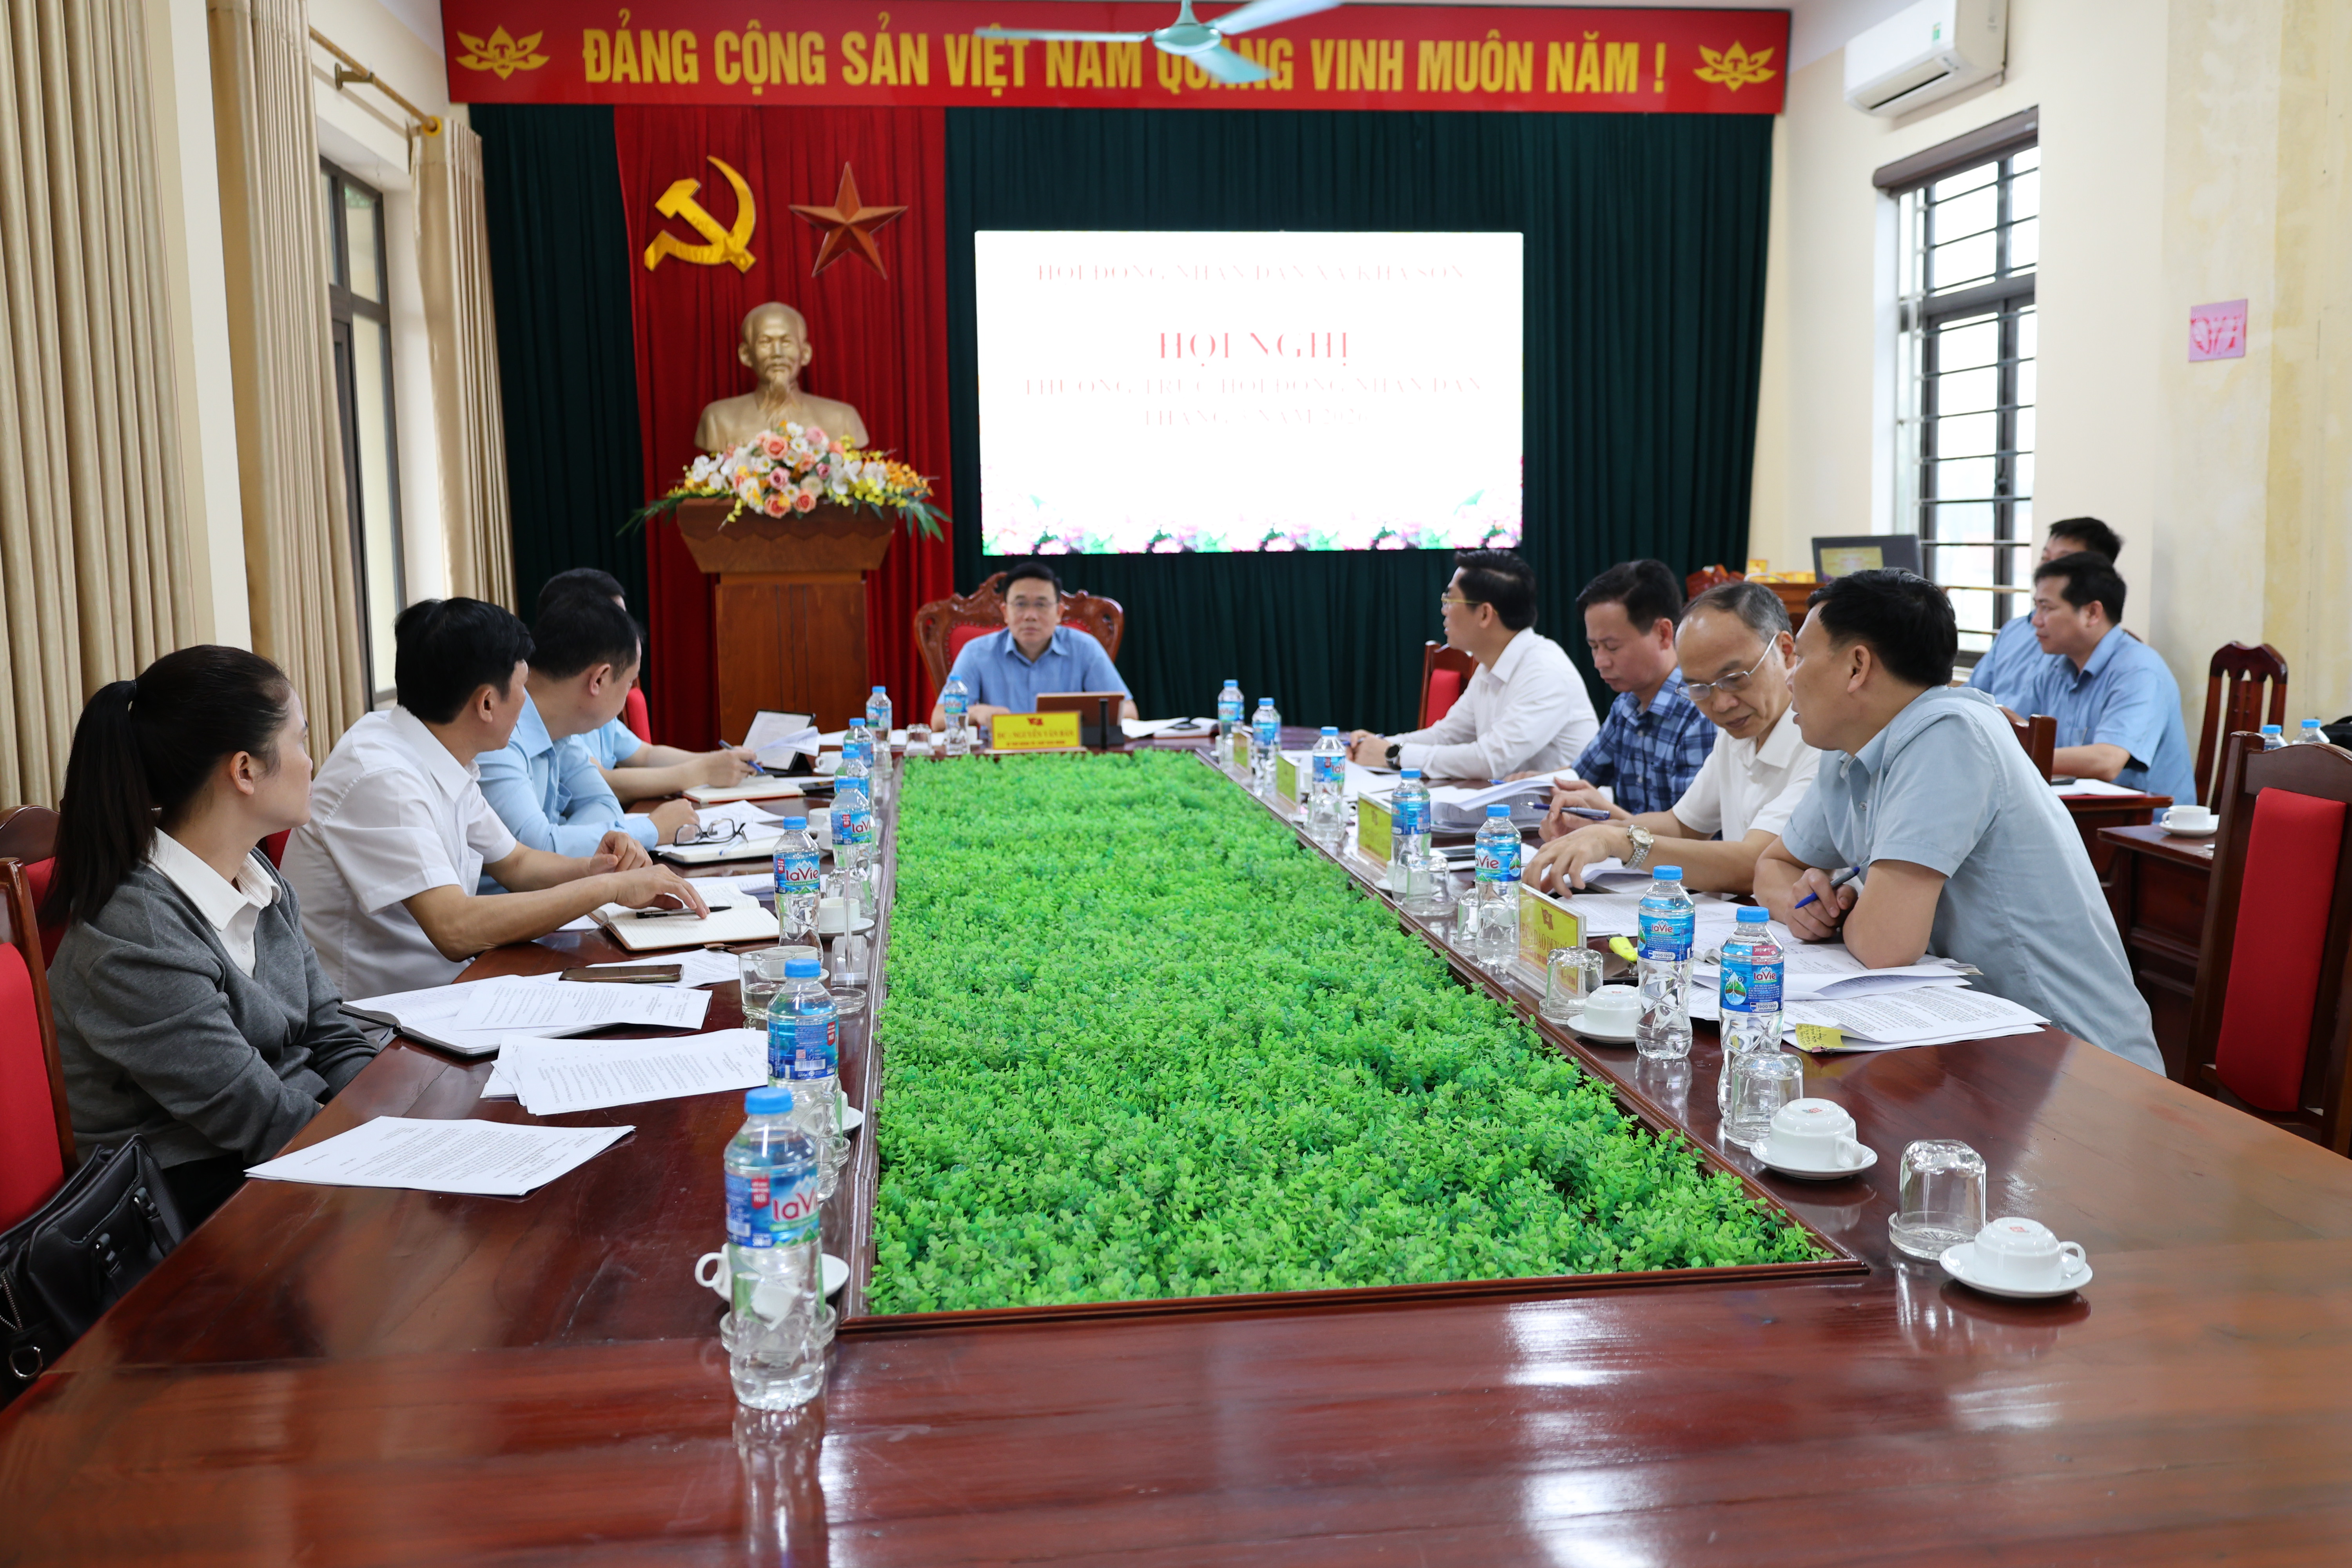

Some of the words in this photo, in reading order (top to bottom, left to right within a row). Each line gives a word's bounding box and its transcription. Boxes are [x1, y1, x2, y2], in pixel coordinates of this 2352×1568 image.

[583, 8, 699, 84] ĐẢNG
[715, 19, 826, 95] CỘNG
[842, 12, 929, 86] SẢN
[1047, 33, 1142, 89] NAM
[1311, 40, 1403, 92] VINH
[1417, 30, 1534, 92] MUÔN
[1546, 31, 1639, 93] NĂM
[1475, 854, 1499, 869] aVie
[786, 867, 818, 881] laVie
[1651, 924, 1673, 933] laVie
[1754, 971, 1776, 980] laVie
